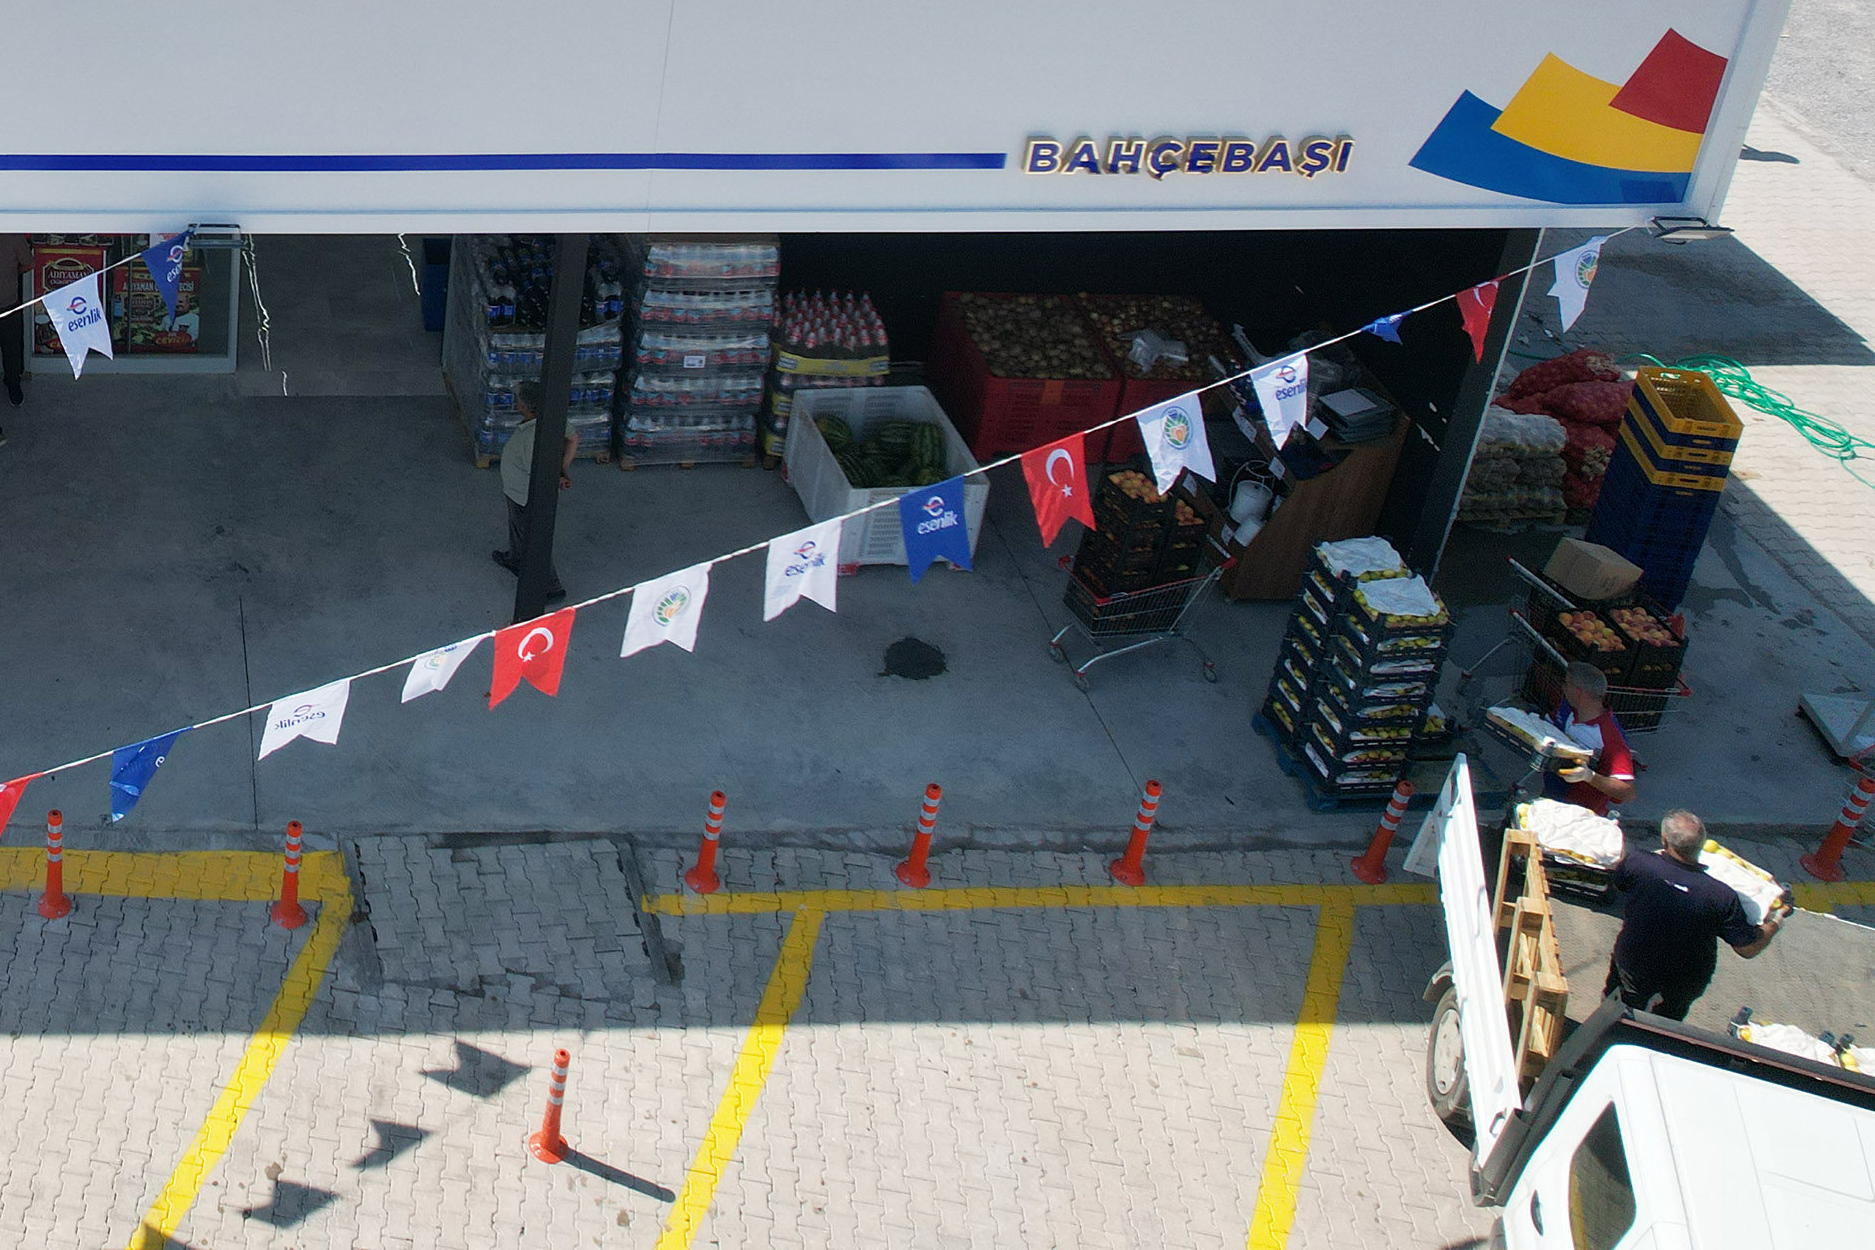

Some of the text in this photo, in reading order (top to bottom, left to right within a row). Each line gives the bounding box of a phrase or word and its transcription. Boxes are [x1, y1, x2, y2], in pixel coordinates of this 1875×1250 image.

[1022, 135, 1356, 180] BAHÇEBAŞI
[123, 281, 154, 292] AIYAMAN
[68, 307, 102, 332] esenlik
[918, 511, 958, 535] esenlik
